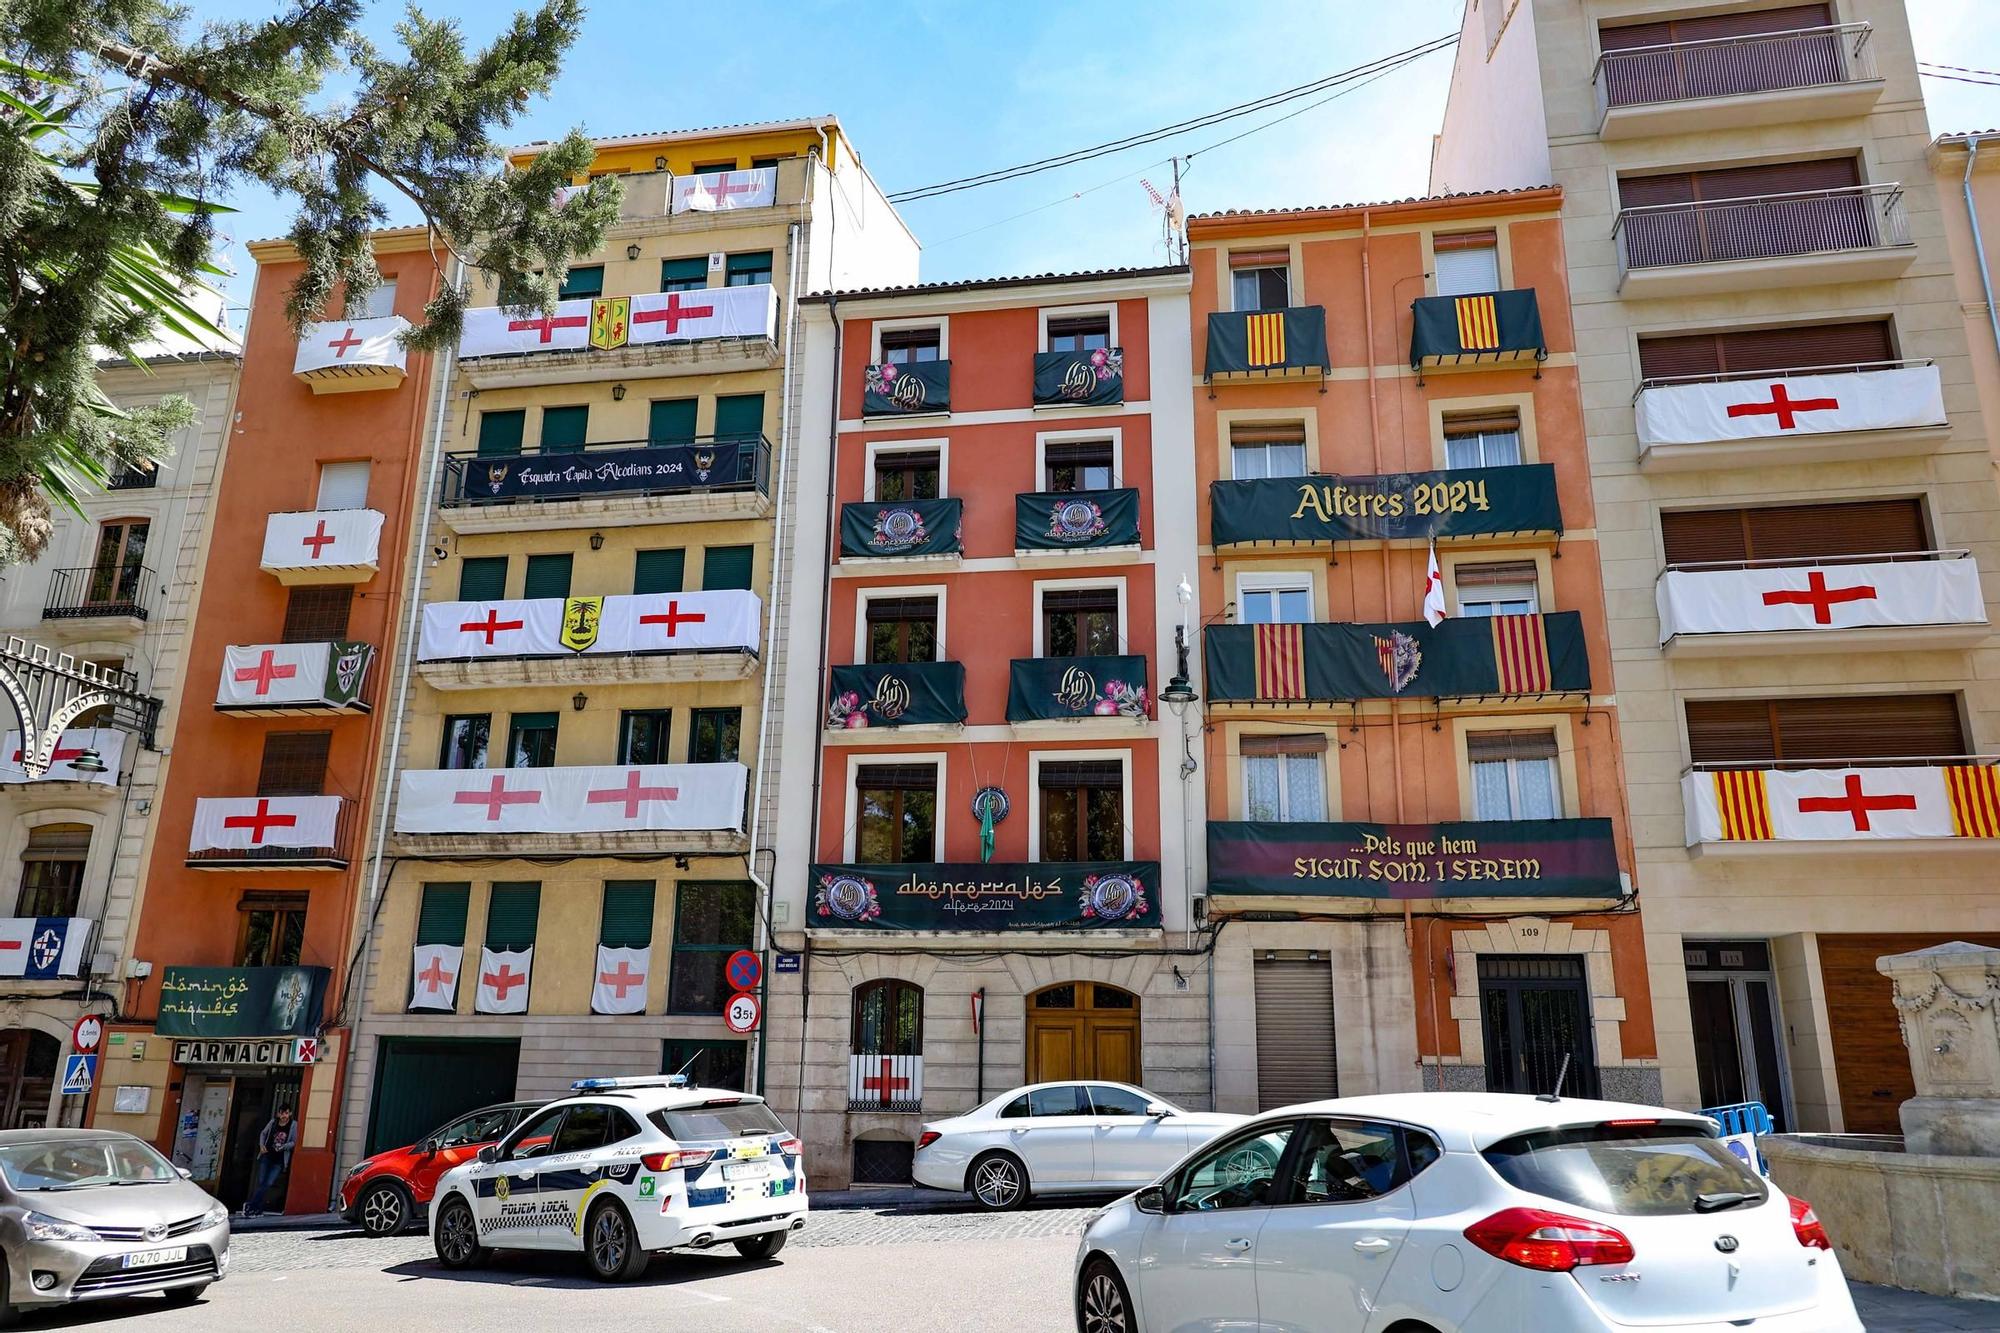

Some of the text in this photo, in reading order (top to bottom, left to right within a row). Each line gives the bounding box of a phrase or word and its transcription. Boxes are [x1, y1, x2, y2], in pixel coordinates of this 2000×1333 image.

[518, 462, 683, 486] Esquadra Capità Alcodians 2024
[1290, 479, 1490, 523] Alferes 2024
[1406, 839, 1435, 860] que
[1441, 836, 1477, 854] hem
[1436, 861, 1445, 881] I
[1451, 858, 1541, 882] SEREM
[1521, 928, 1539, 937] 109
[501, 1200, 569, 1215] POLICIA LOCAL
[1718, 1237, 1736, 1250] KIA
[132, 1249, 183, 1265] 0470 JJL
